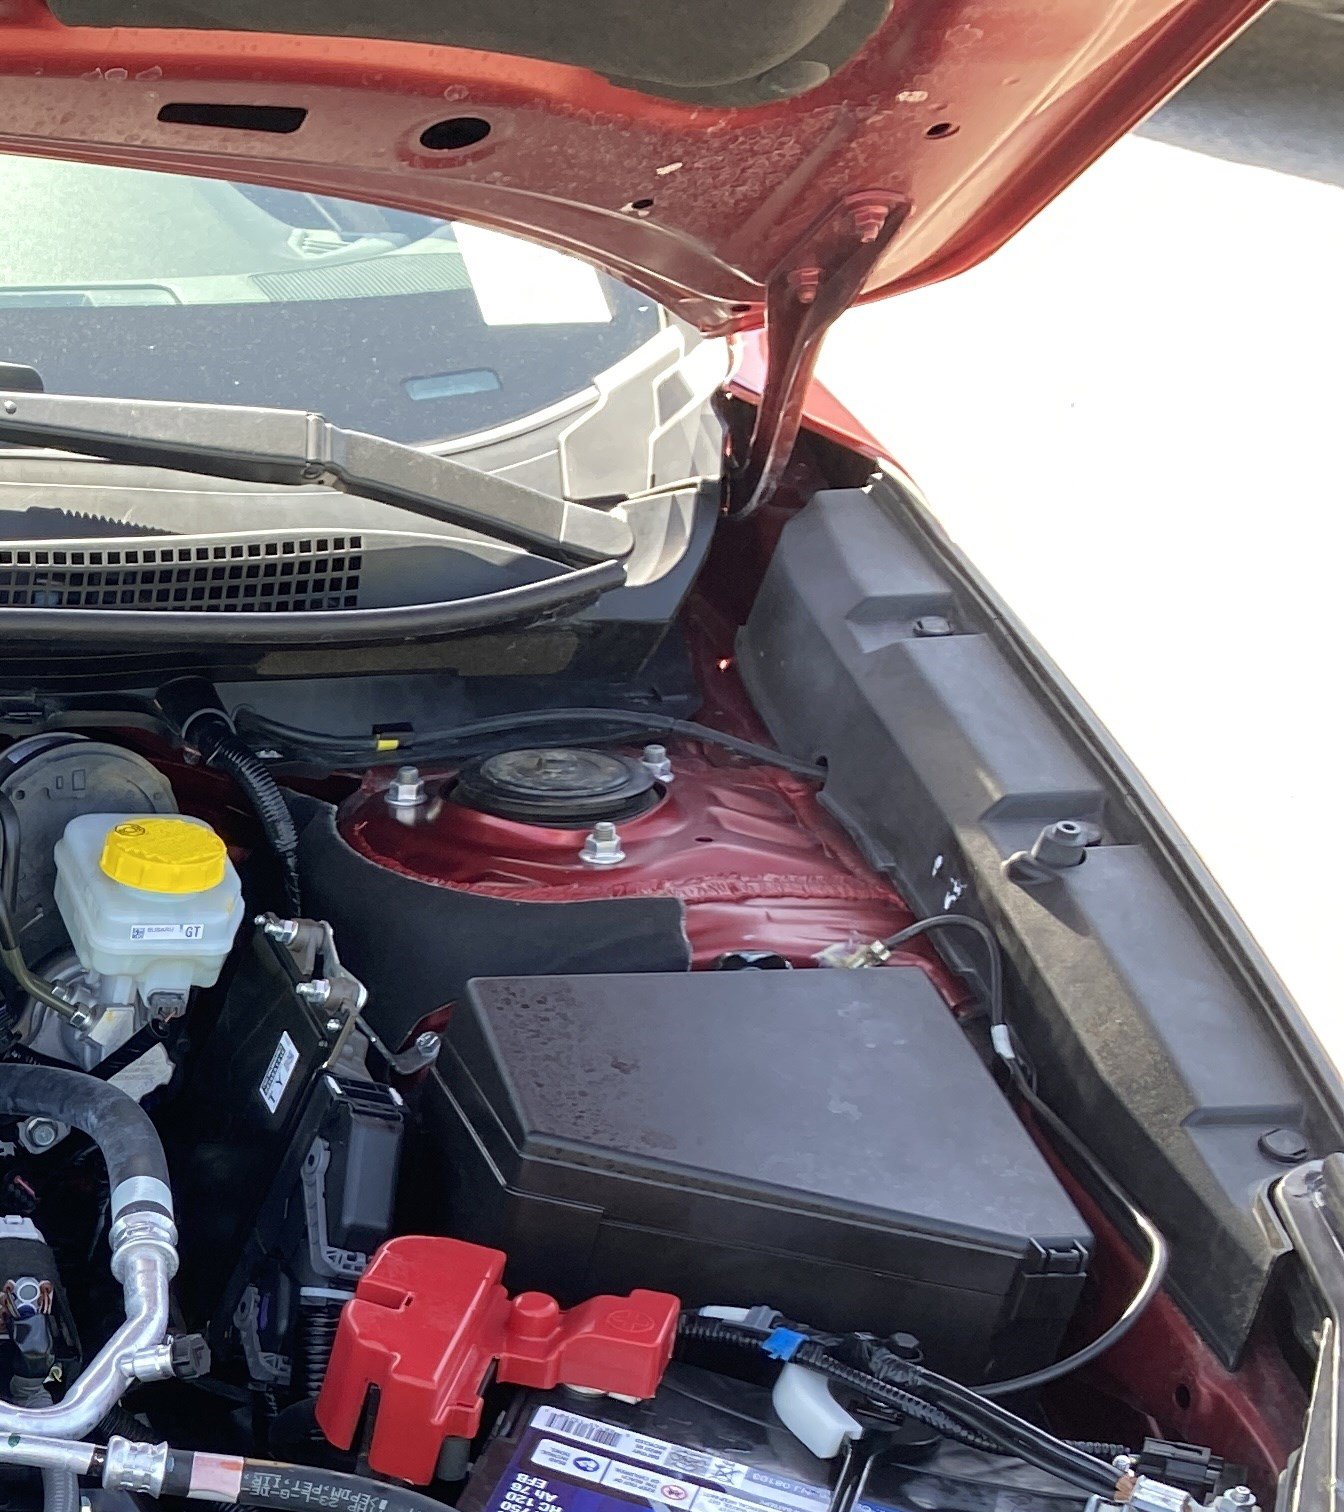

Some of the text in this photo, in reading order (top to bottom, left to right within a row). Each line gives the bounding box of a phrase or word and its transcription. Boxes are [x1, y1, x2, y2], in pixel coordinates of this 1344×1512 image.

[185, 926, 201, 938] GT
[515, 1472, 549, 1490] EFB
[505, 1491, 534, 1507] 120
[510, 1481, 559, 1503] Ah 76
